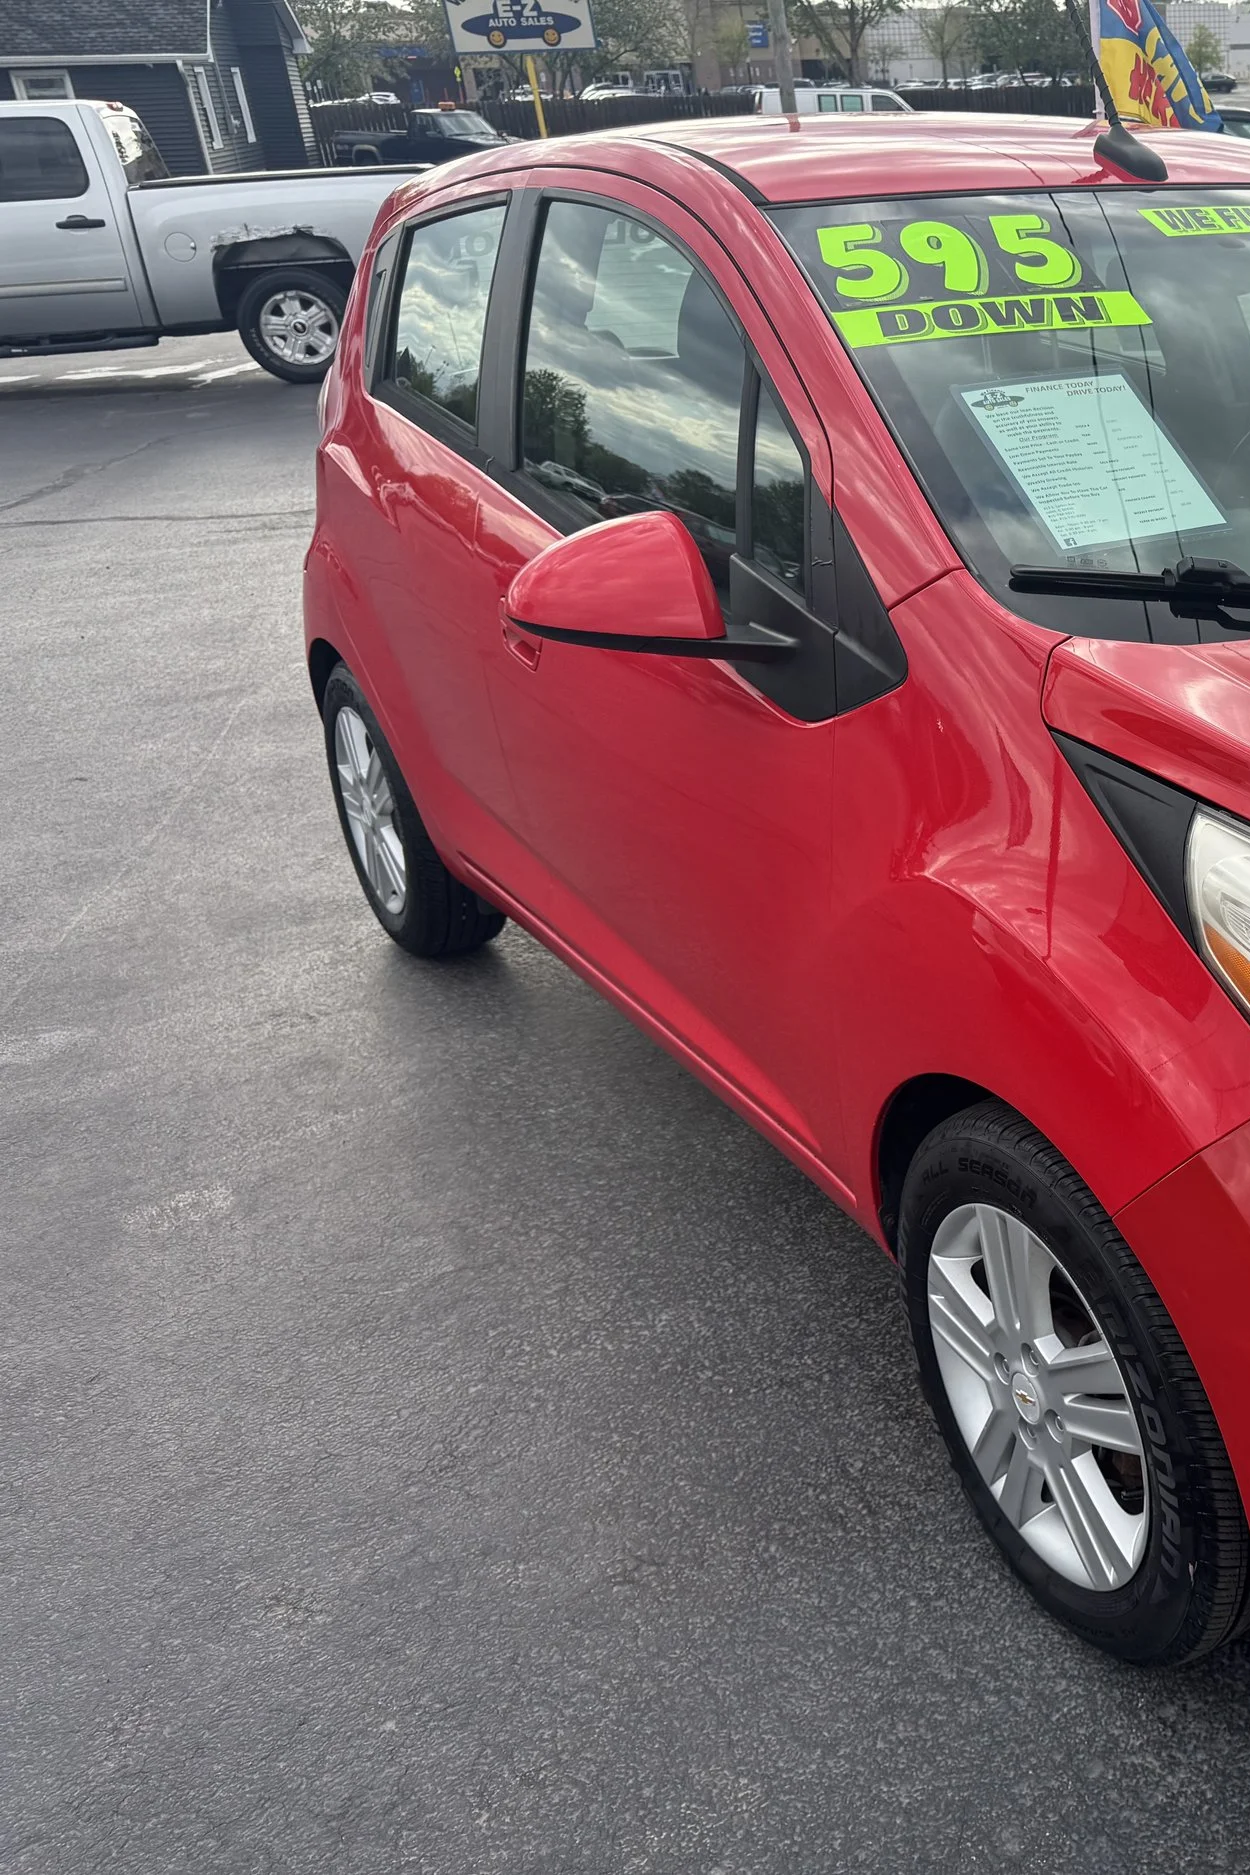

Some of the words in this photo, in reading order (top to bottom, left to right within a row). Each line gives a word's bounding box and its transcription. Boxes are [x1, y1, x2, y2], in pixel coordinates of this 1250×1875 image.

[498, 0, 538, 17] E-Z
[488, 18, 517, 27] AUTO
[521, 16, 554, 26] SALES
[1153, 209, 1222, 232] WE
[816, 214, 1082, 301] 595
[876, 295, 1111, 341] DOWN
[1025, 384, 1064, 393] FINANCE
[1065, 381, 1094, 389] TODAY
[1066, 388, 1093, 397] DRIVE
[1095, 385, 1126, 393] TODAY!
[957, 1156, 1038, 1209] SEASON
